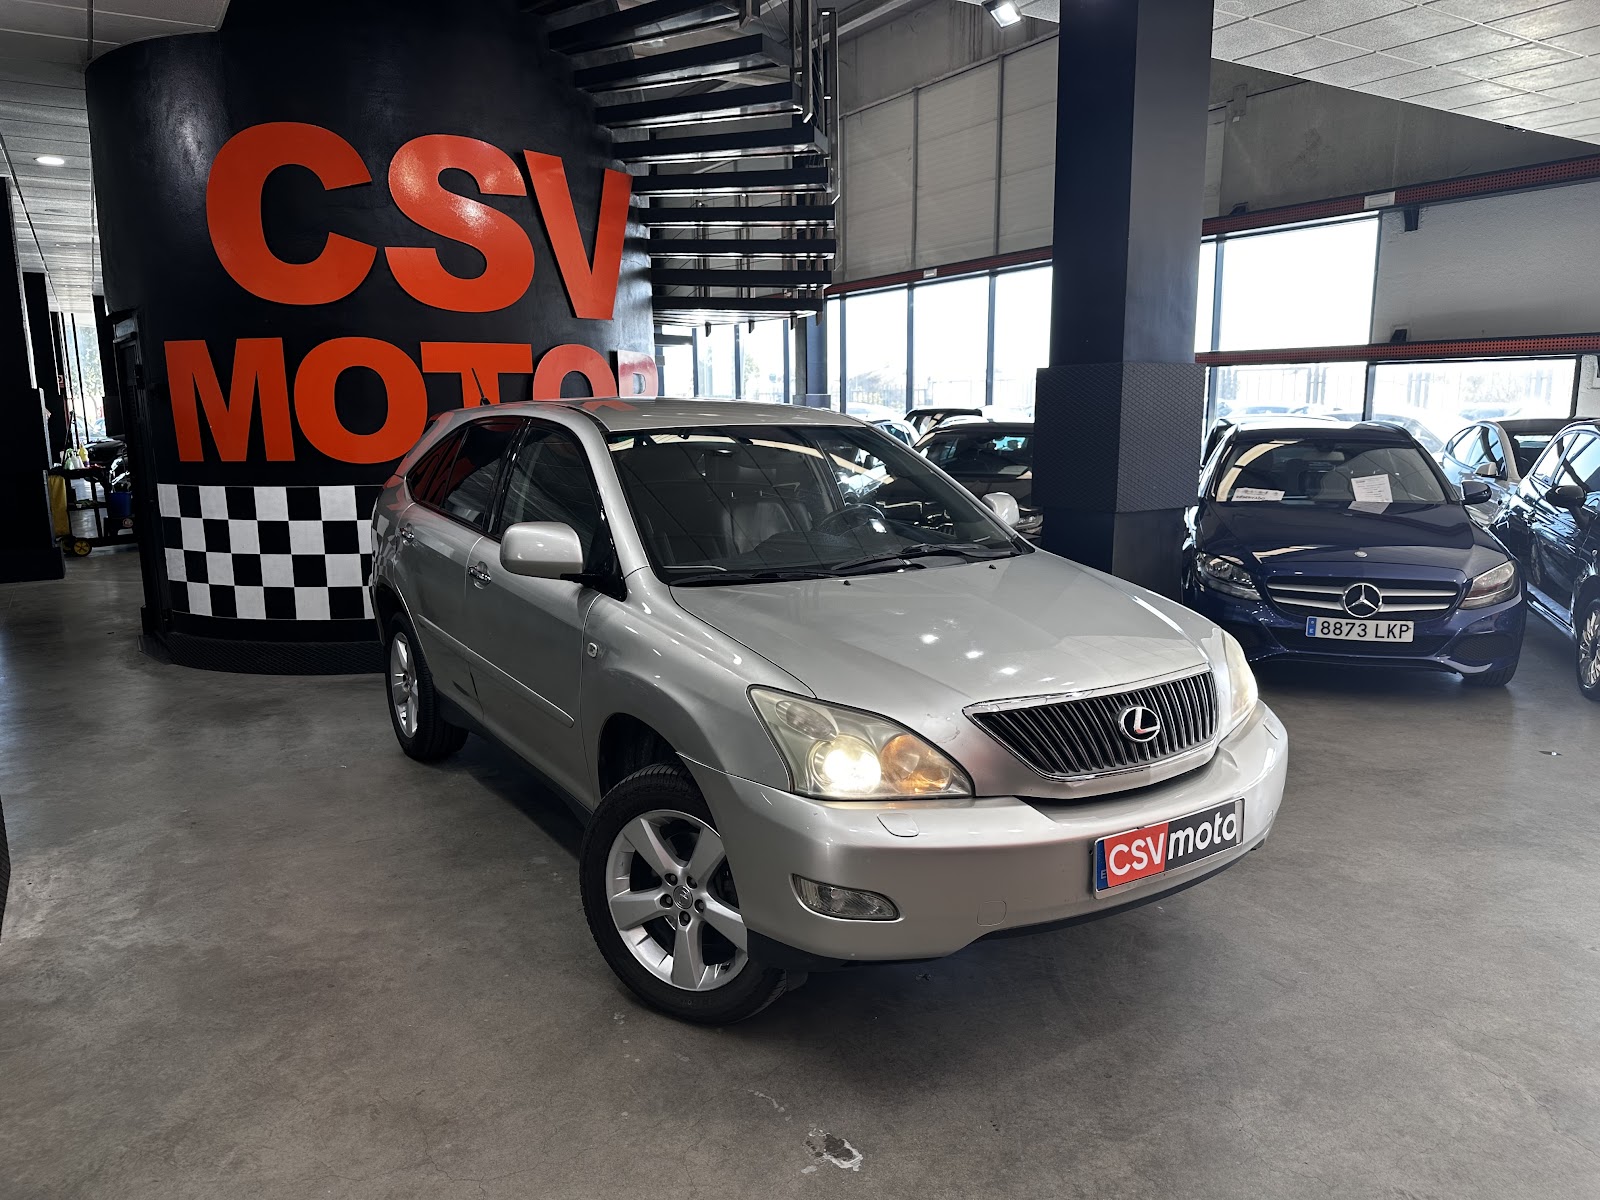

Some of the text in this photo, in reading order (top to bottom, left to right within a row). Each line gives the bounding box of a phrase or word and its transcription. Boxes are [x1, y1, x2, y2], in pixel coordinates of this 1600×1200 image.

[205, 121, 633, 320] CSV
[1320, 620, 1410, 639] 8873 LKP
